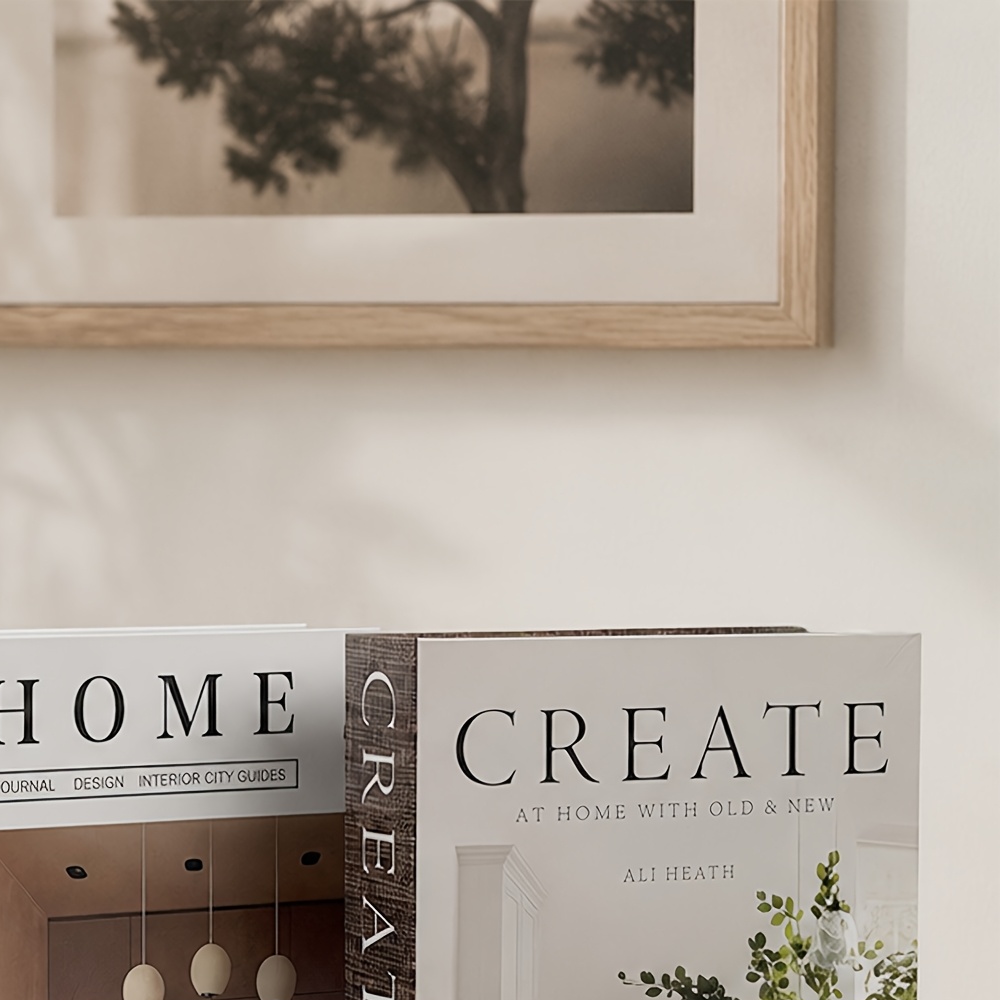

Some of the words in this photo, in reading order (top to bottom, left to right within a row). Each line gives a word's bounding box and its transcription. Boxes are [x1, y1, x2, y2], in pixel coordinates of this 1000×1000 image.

[455, 701, 889, 786] CREATE
[74, 776, 125, 791] DESIGN
[139, 771, 200, 788] INTERIOR
[204, 770, 234, 785] CITY
[237, 768, 286, 783] GUIDES
[515, 807, 545, 823] AT
[557, 804, 627, 822] HOME
[638, 802, 698, 818] WITH
[709, 800, 754, 816] OLD
[764, 799, 778, 814] &
[788, 797, 835, 813] NEW
[623, 867, 656, 883] ALI
[666, 864, 735, 881] HEATH
